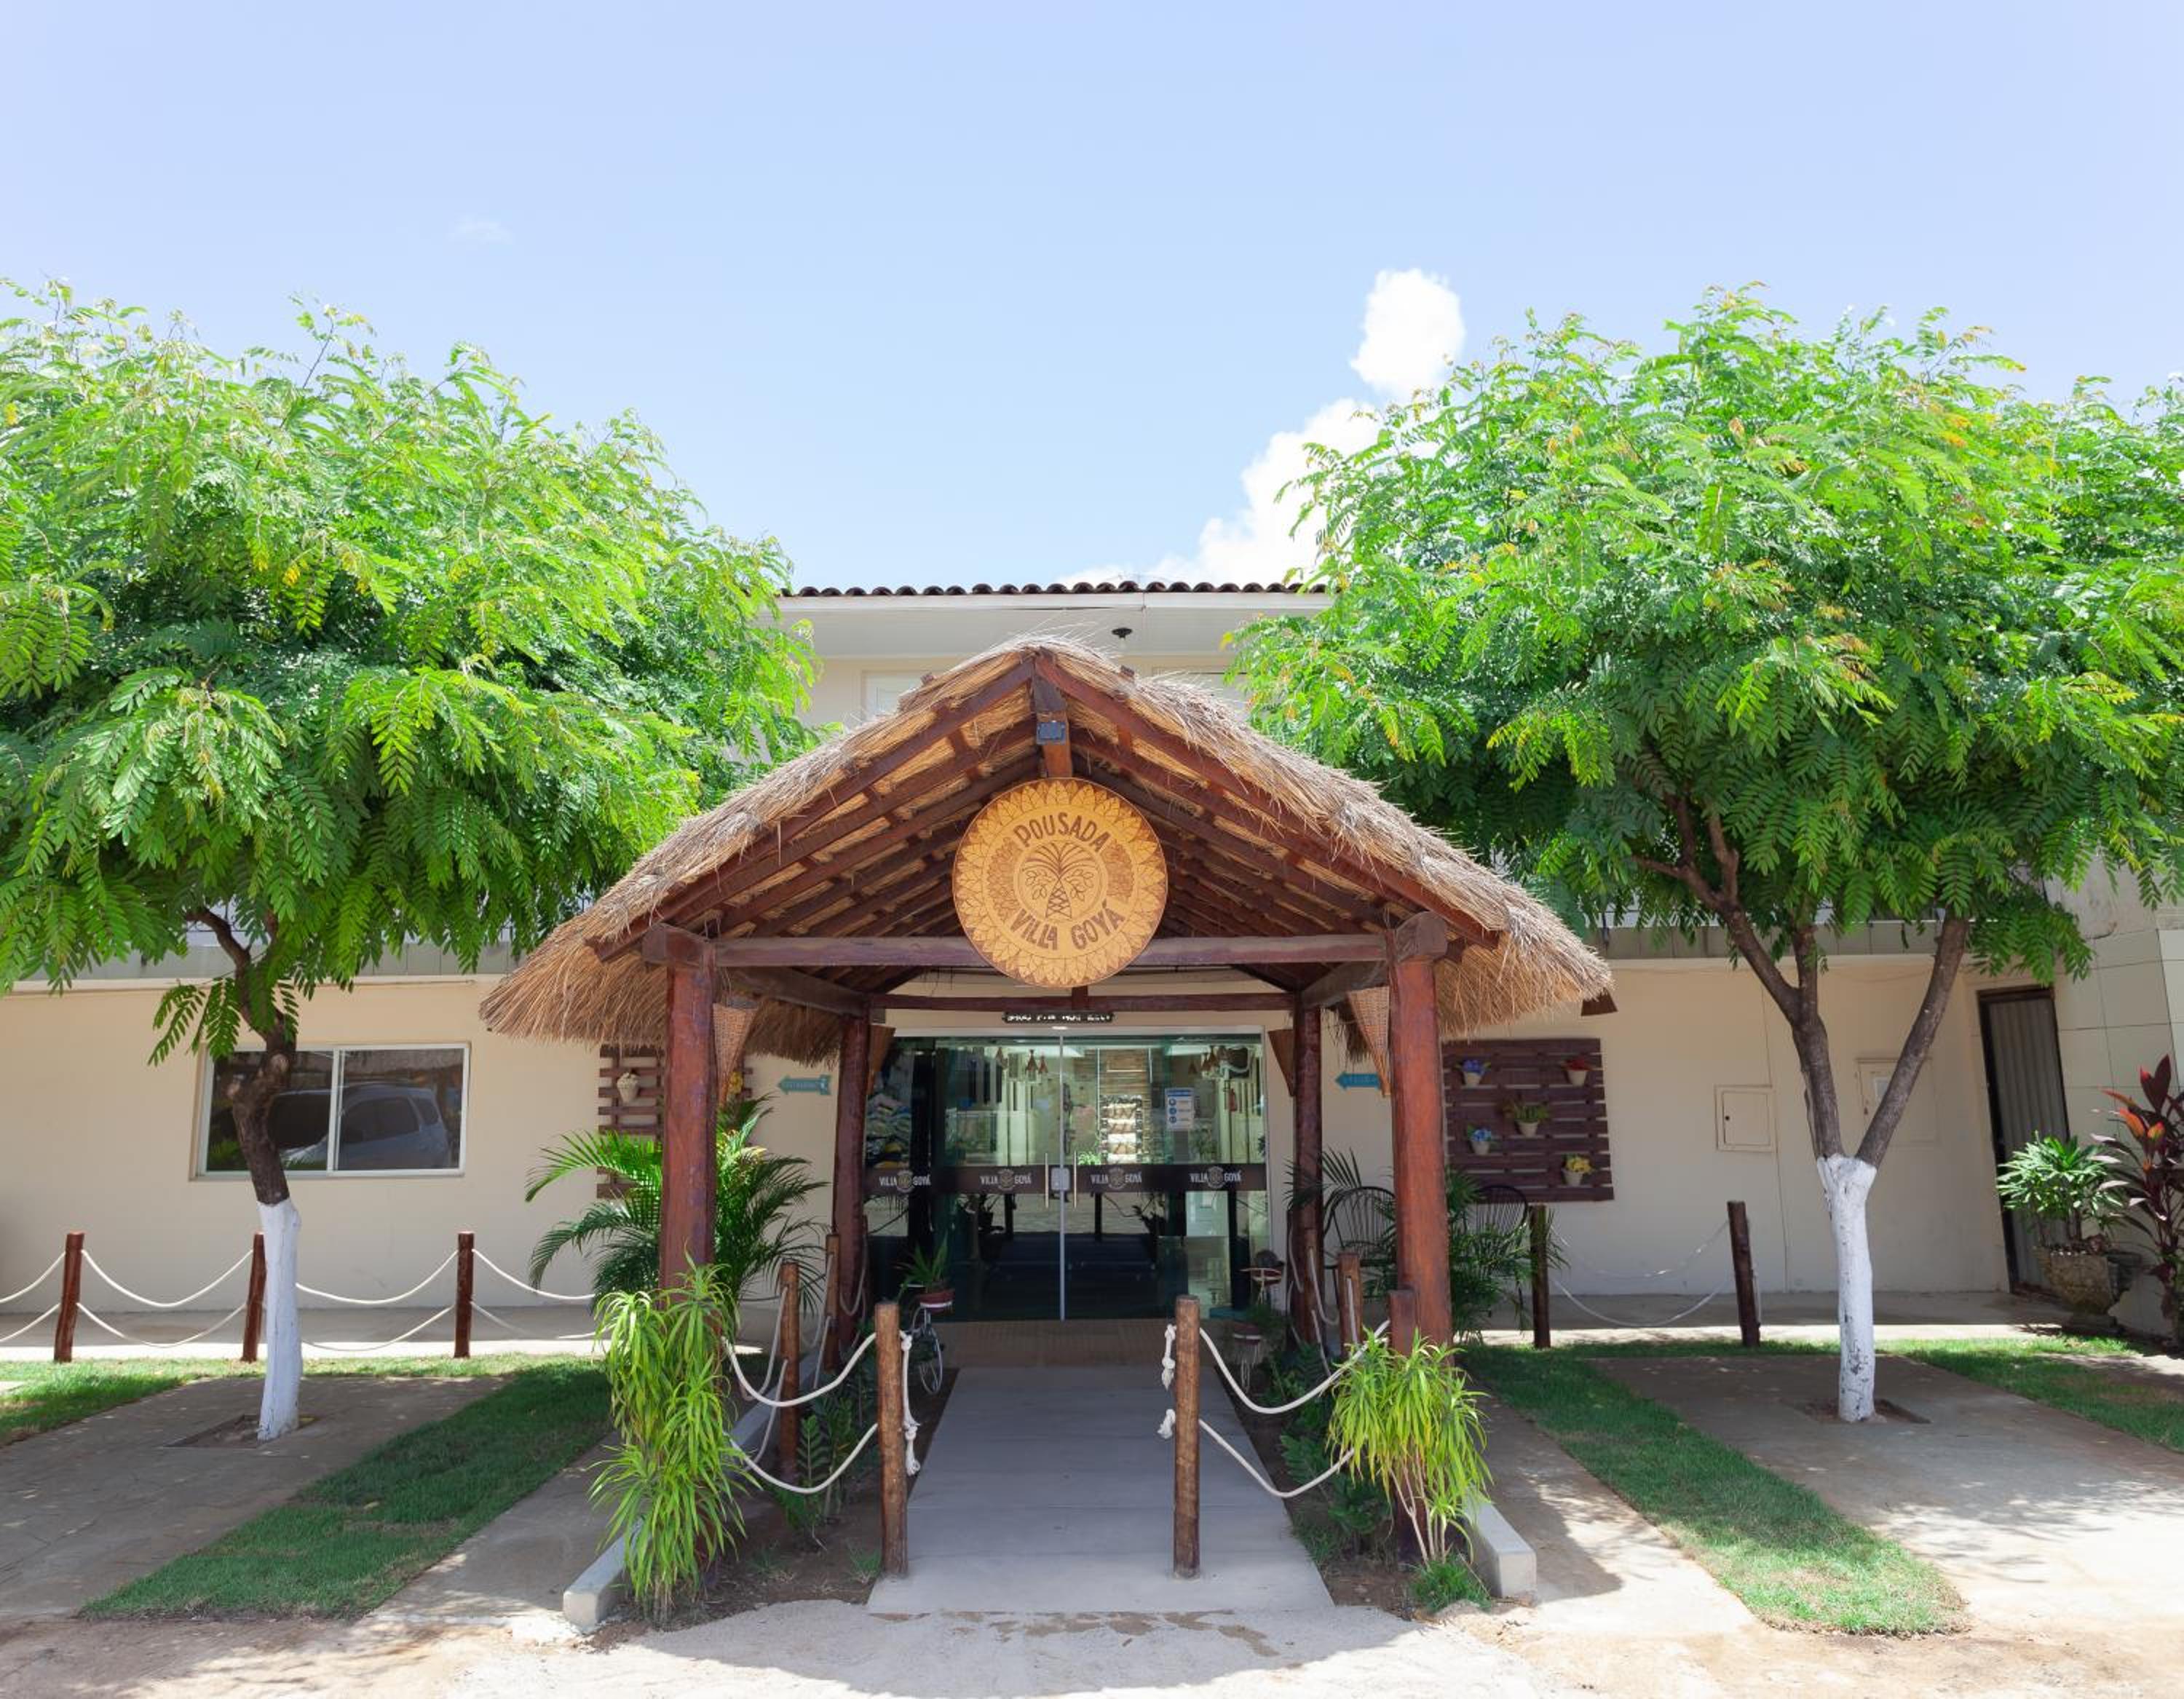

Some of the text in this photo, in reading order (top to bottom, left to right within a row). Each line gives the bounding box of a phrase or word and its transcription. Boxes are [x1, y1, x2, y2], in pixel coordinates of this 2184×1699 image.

[1013, 812, 1112, 852] POUSADA
[1010, 898, 1125, 950] VILLA GOYÁ
